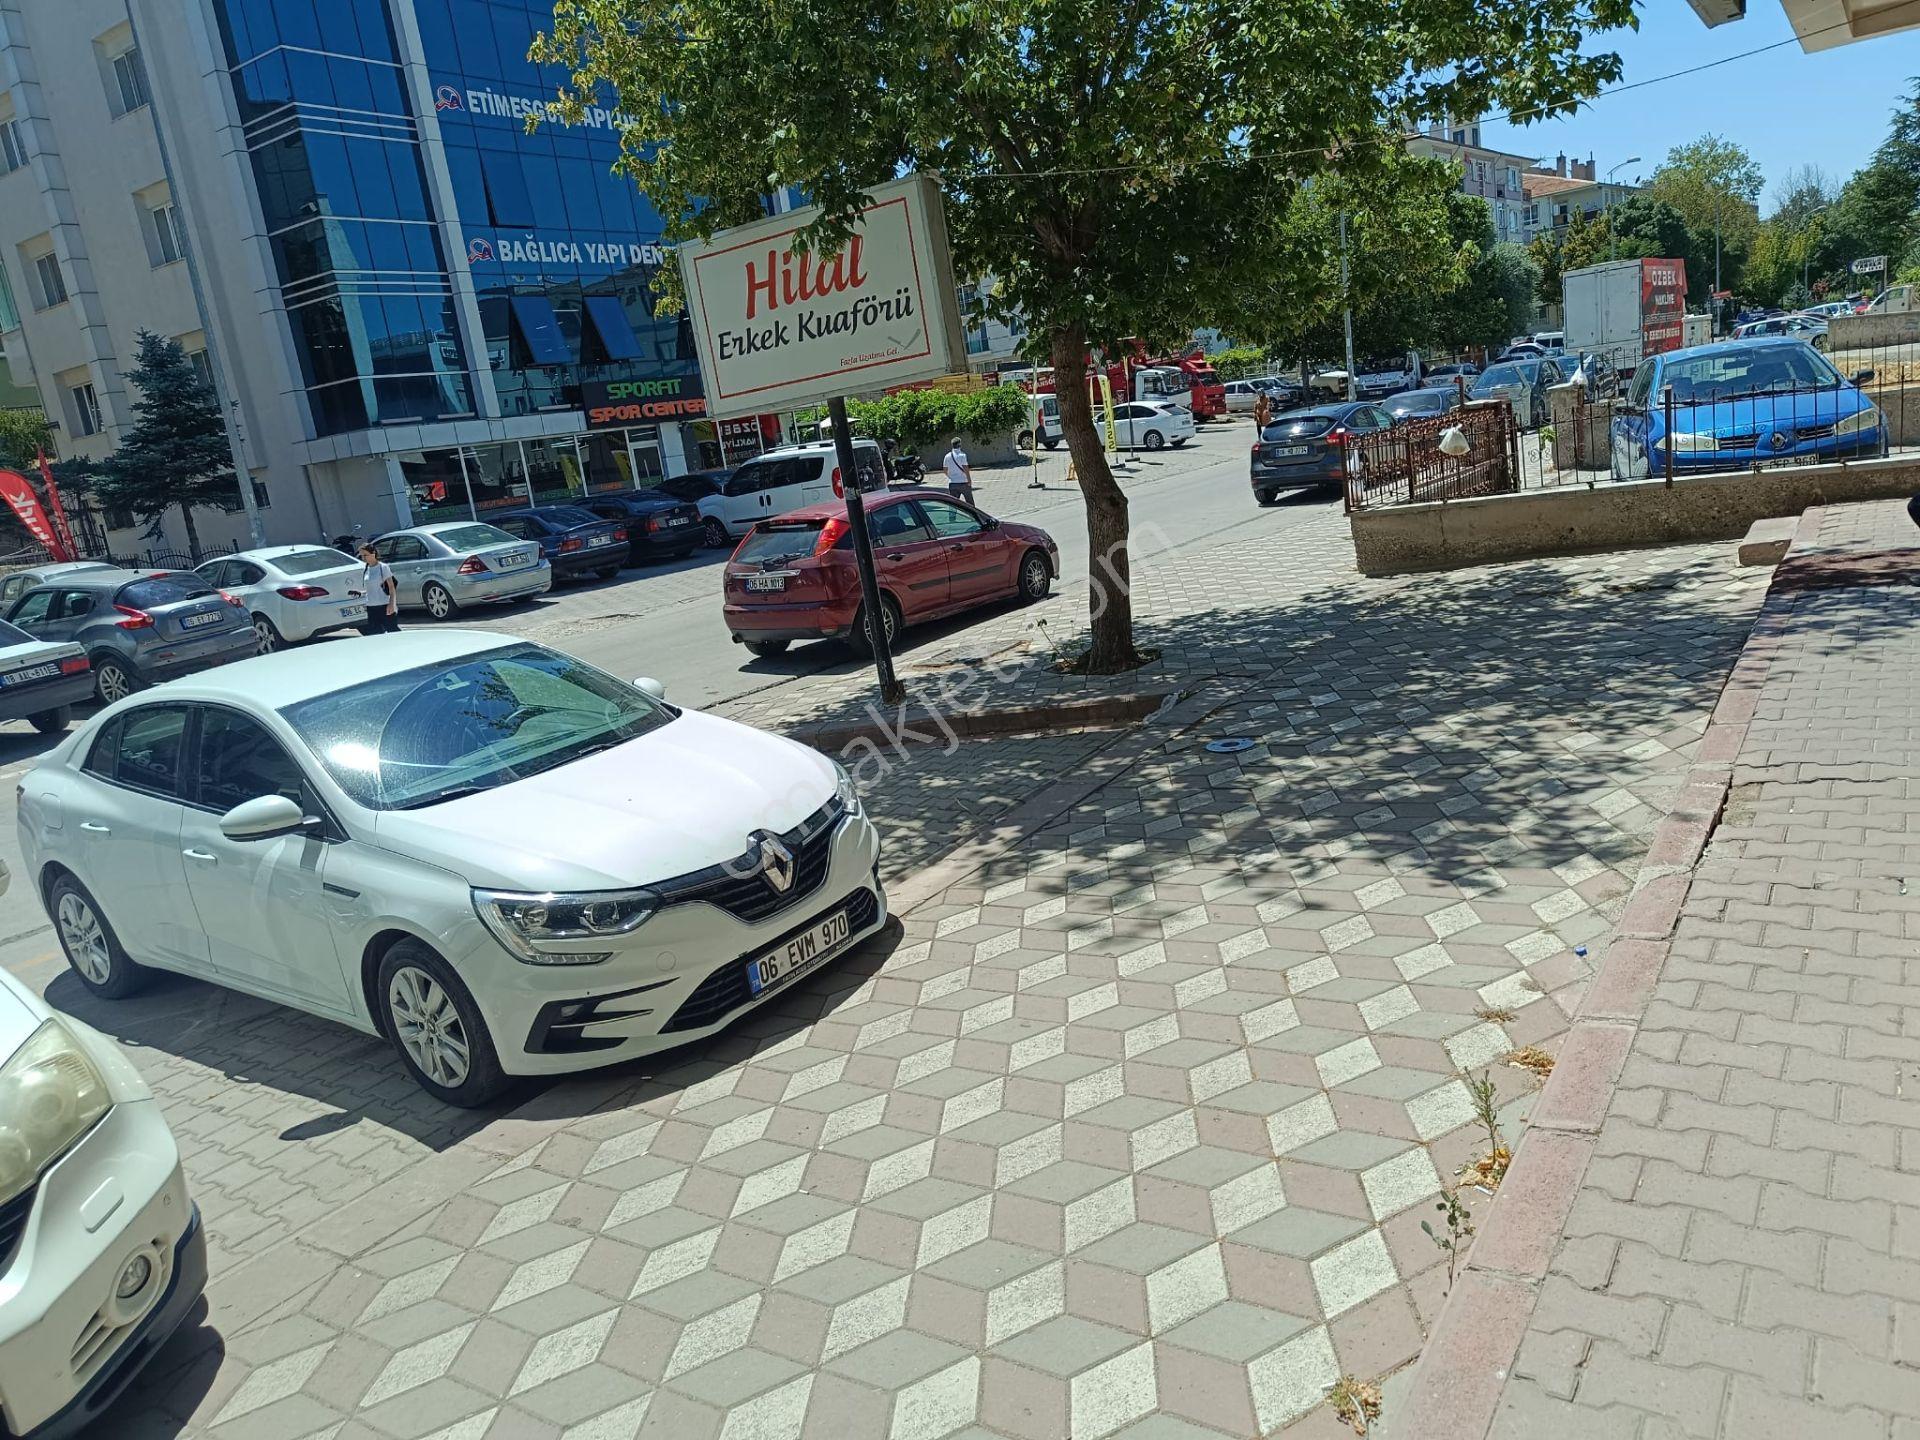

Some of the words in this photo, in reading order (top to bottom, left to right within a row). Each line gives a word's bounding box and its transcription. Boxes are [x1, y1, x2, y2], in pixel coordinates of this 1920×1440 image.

[497, 235, 583, 263] BAĞLICA
[584, 243, 627, 264] YAPI
[745, 234, 868, 320] Hilal
[717, 320, 790, 361] Erkek
[797, 287, 915, 343] Kuaförü
[606, 378, 682, 400] SPORFIT
[588, 404, 642, 424] SPOR
[641, 398, 707, 418] CENTER
[749, 580, 758, 589] 06
[760, 579, 769, 588] HA
[760, 955, 779, 984] 06
[787, 932, 817, 967] EVM
[822, 914, 847, 946] 970
